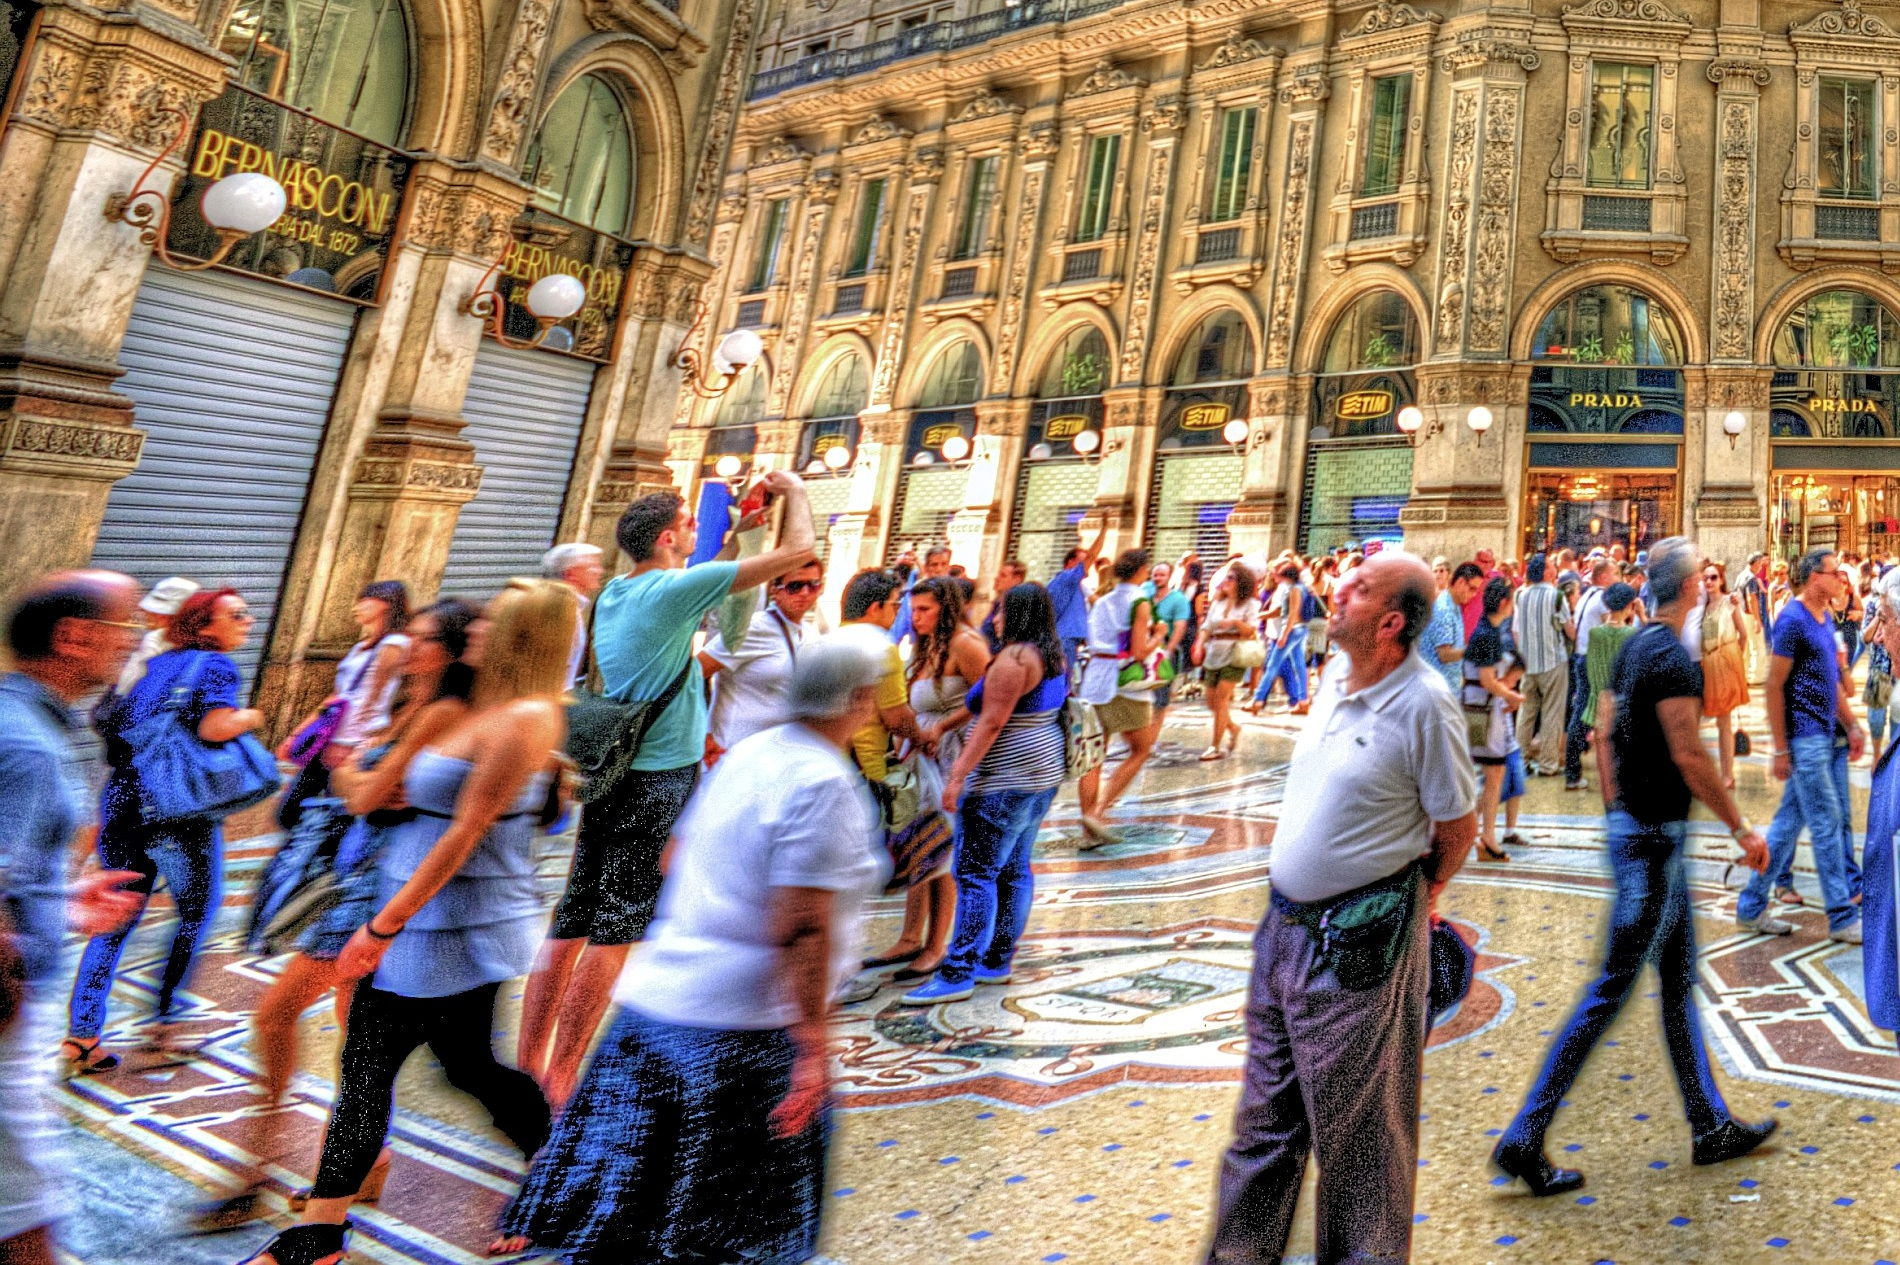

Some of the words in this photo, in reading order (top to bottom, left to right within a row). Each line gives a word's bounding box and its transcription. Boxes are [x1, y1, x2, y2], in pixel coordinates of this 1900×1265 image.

[193, 129, 392, 233] BERNASCONI
[298, 220, 325, 247] DAL
[328, 229, 358, 255] 1872
[1361, 395, 1387, 413] TIM
[1570, 393, 1643, 408] PRADA
[1808, 399, 1878, 413] PRADA
[1202, 407, 1227, 424] TIM
[1034, 998, 1128, 1018] SPQR
